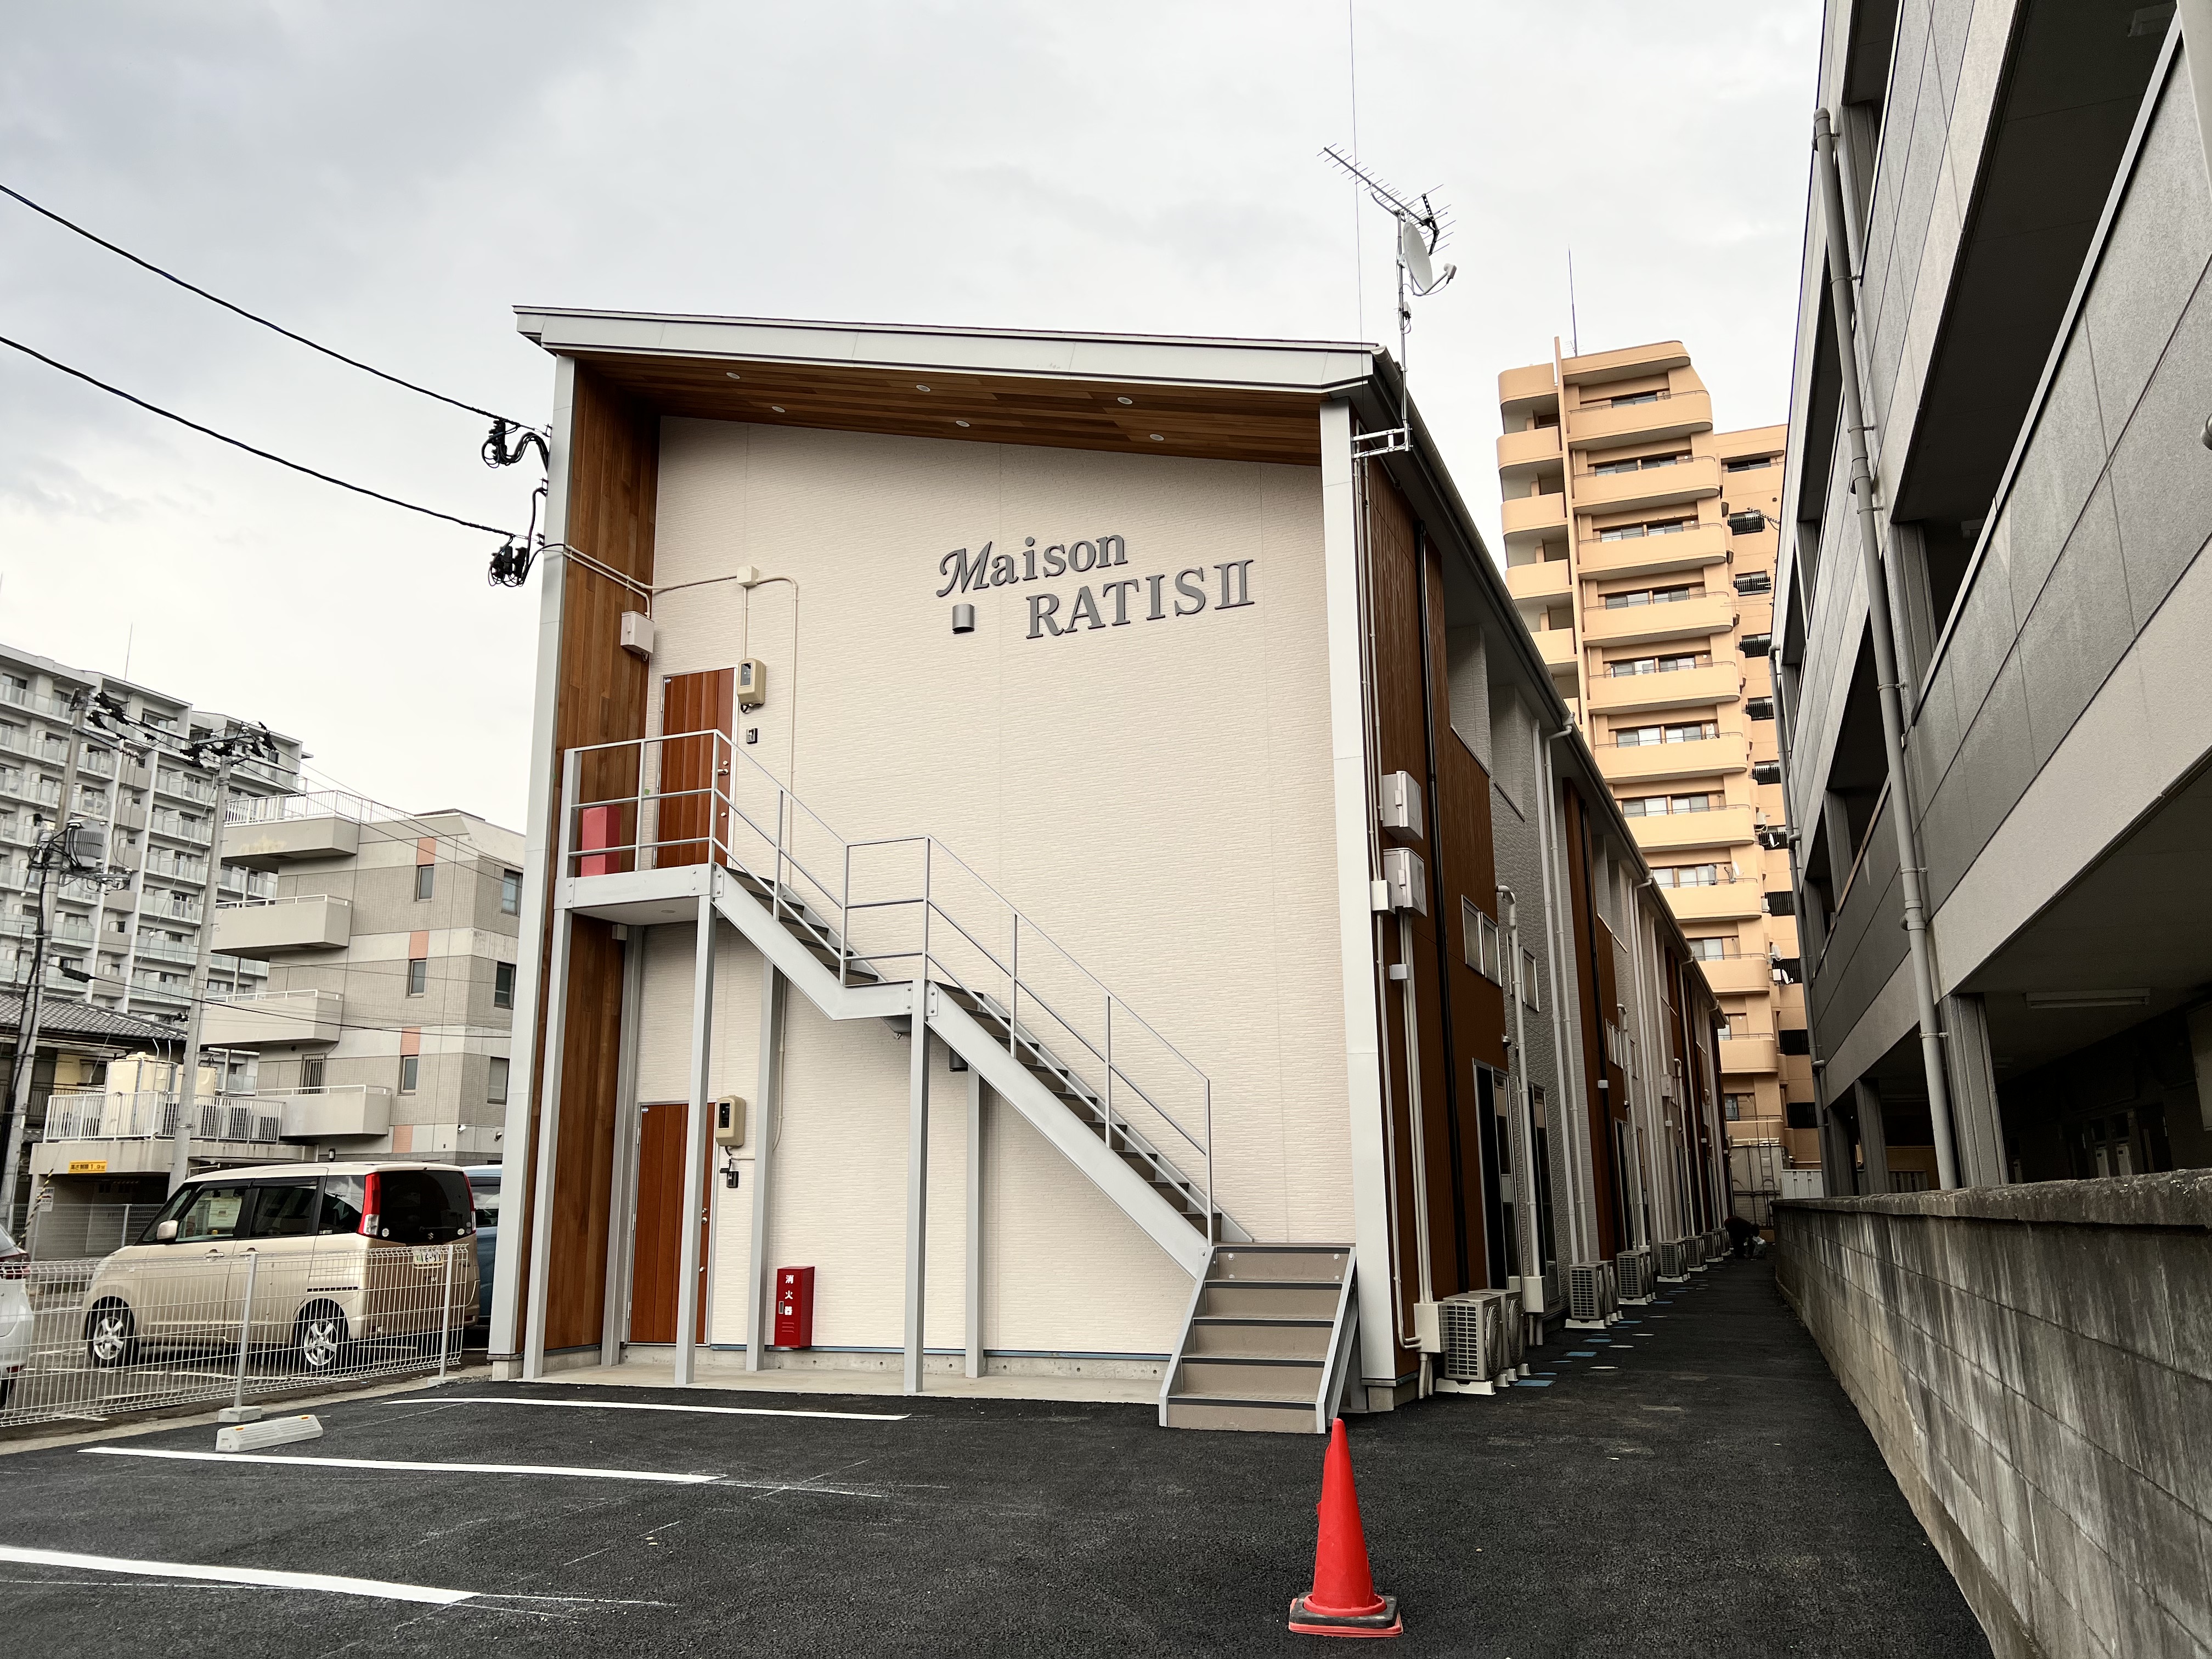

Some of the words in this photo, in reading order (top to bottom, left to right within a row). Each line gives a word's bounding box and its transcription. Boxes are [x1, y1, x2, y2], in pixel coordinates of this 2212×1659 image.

[936, 534, 1127, 597] Maison
[784, 1274, 794, 1316] 消火器
